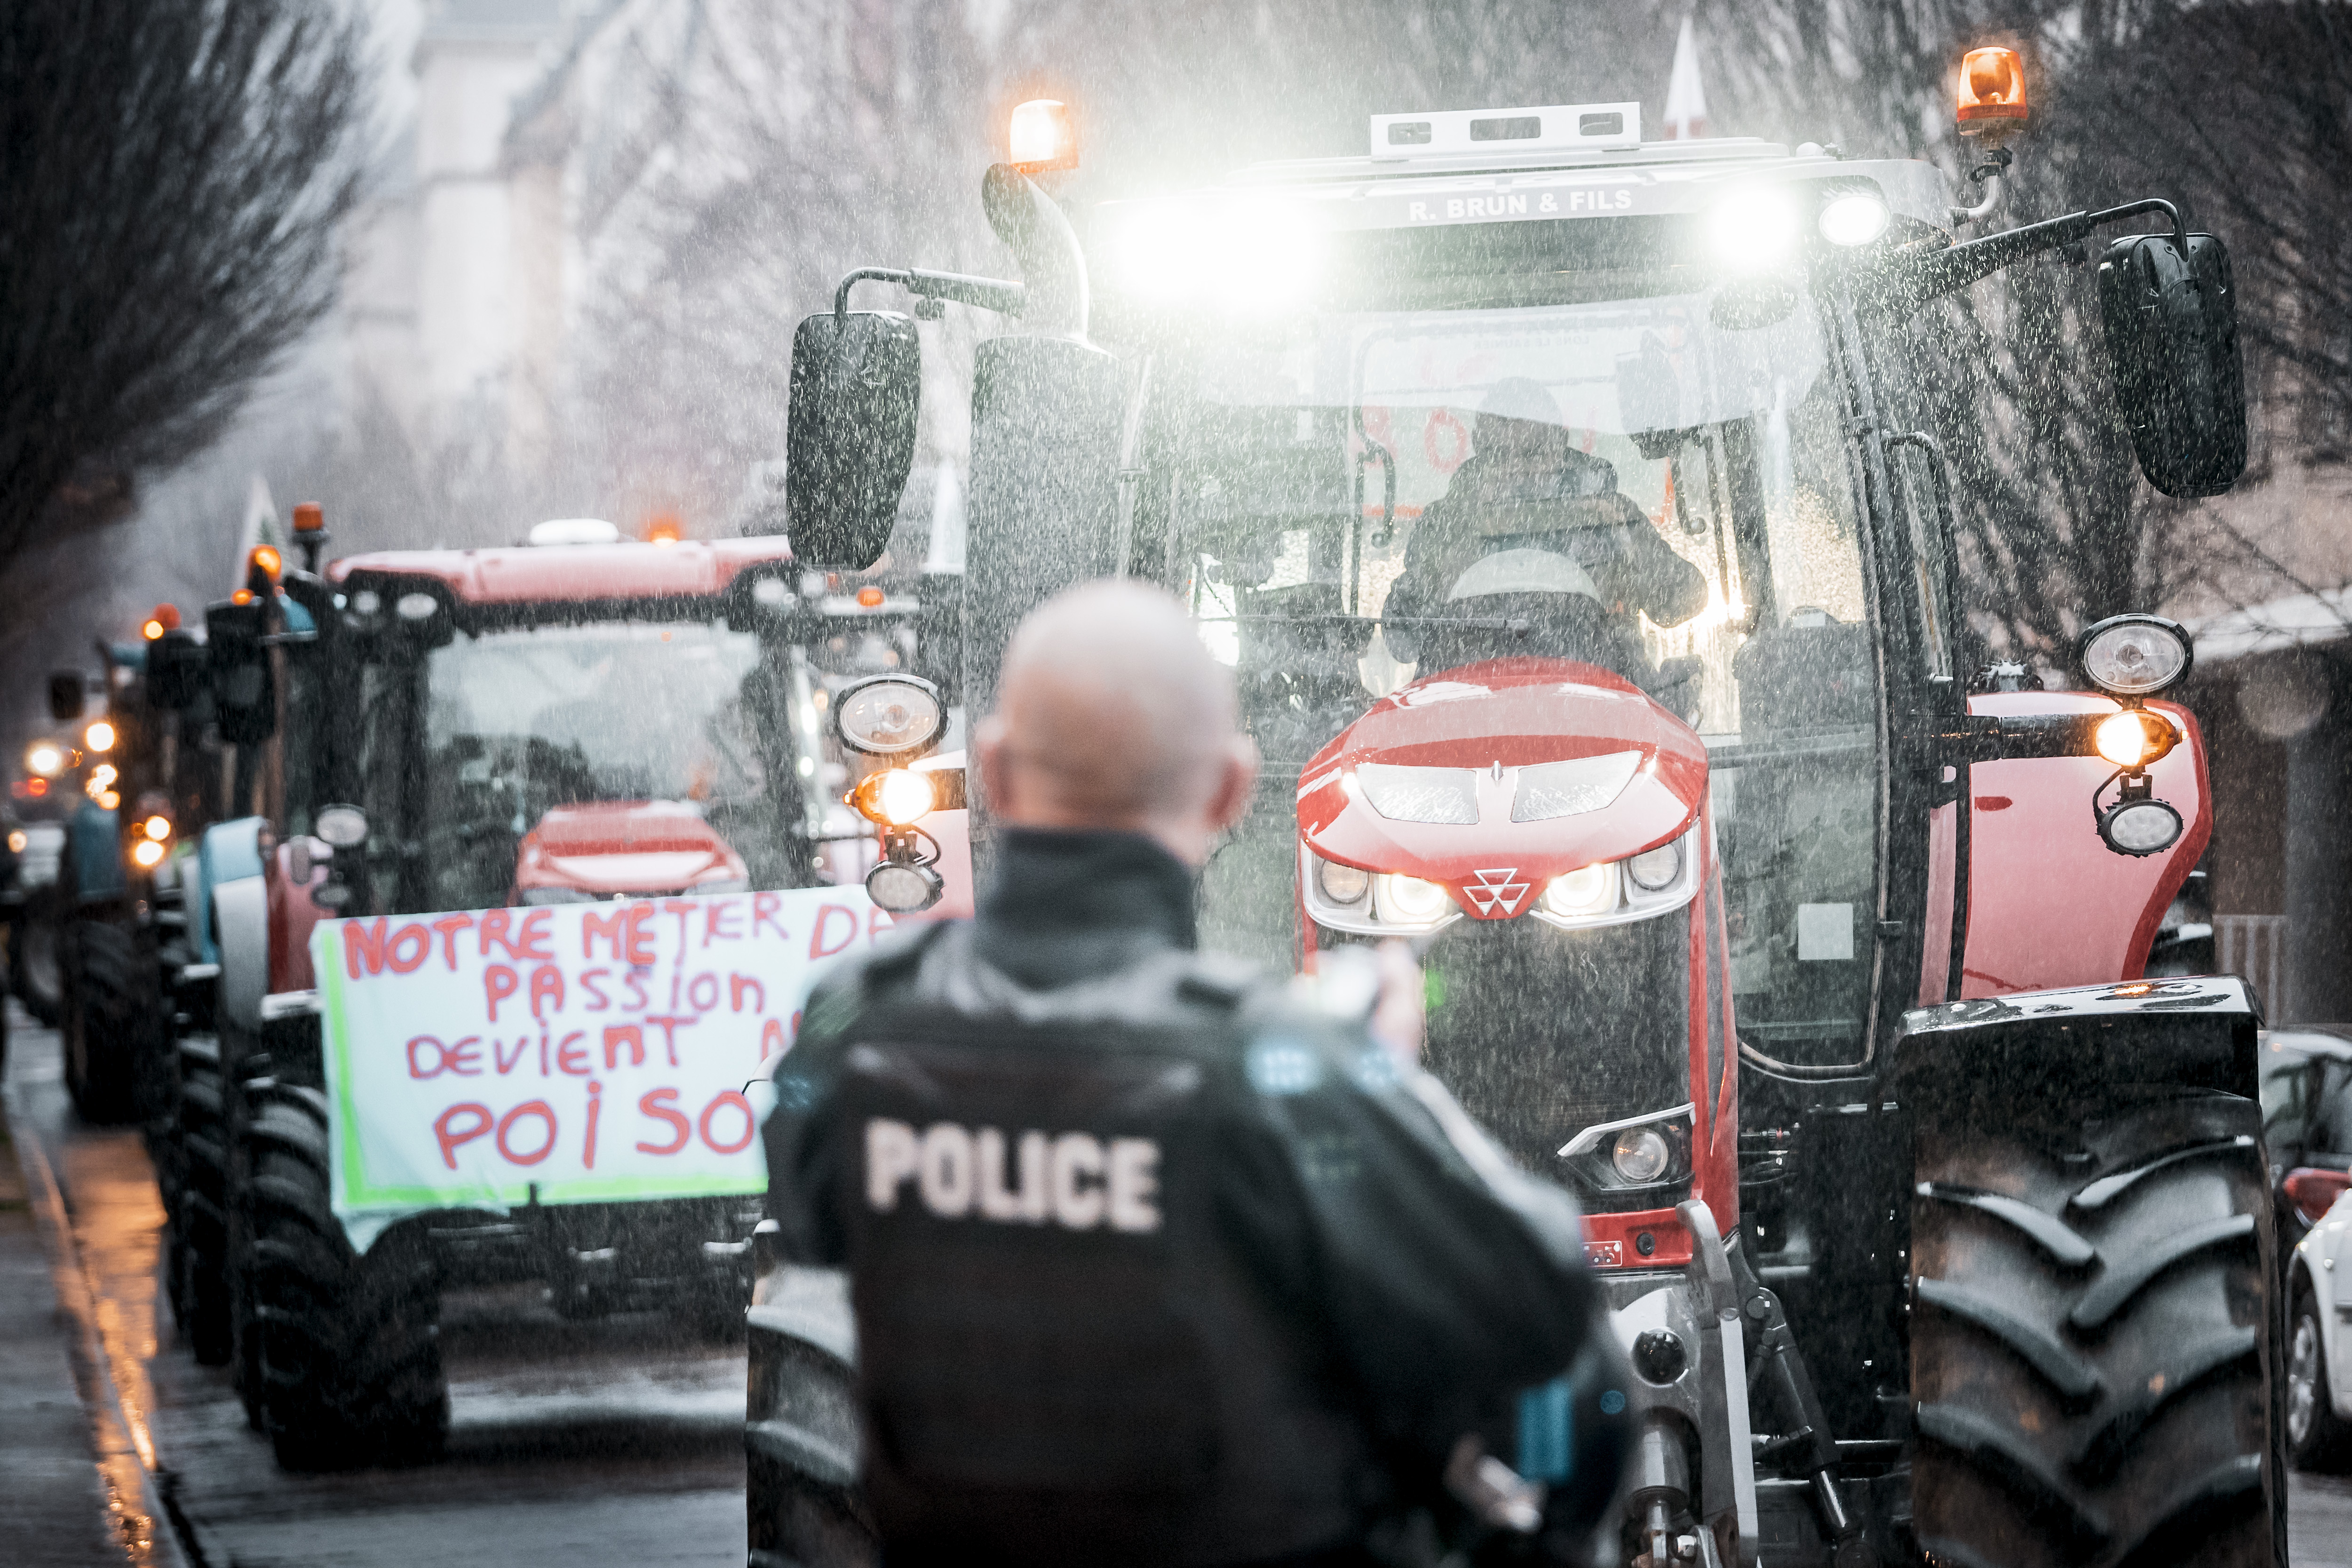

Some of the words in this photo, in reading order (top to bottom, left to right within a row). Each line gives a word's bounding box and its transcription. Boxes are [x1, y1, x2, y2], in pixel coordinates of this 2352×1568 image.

[1409, 202, 1436, 221] R.
[1447, 194, 1527, 218] BRUN
[1539, 193, 1558, 212] &
[1570, 190, 1632, 210] FILS
[343, 907, 555, 979] NOTRE
[866, 1117, 1161, 1232] POLICE
